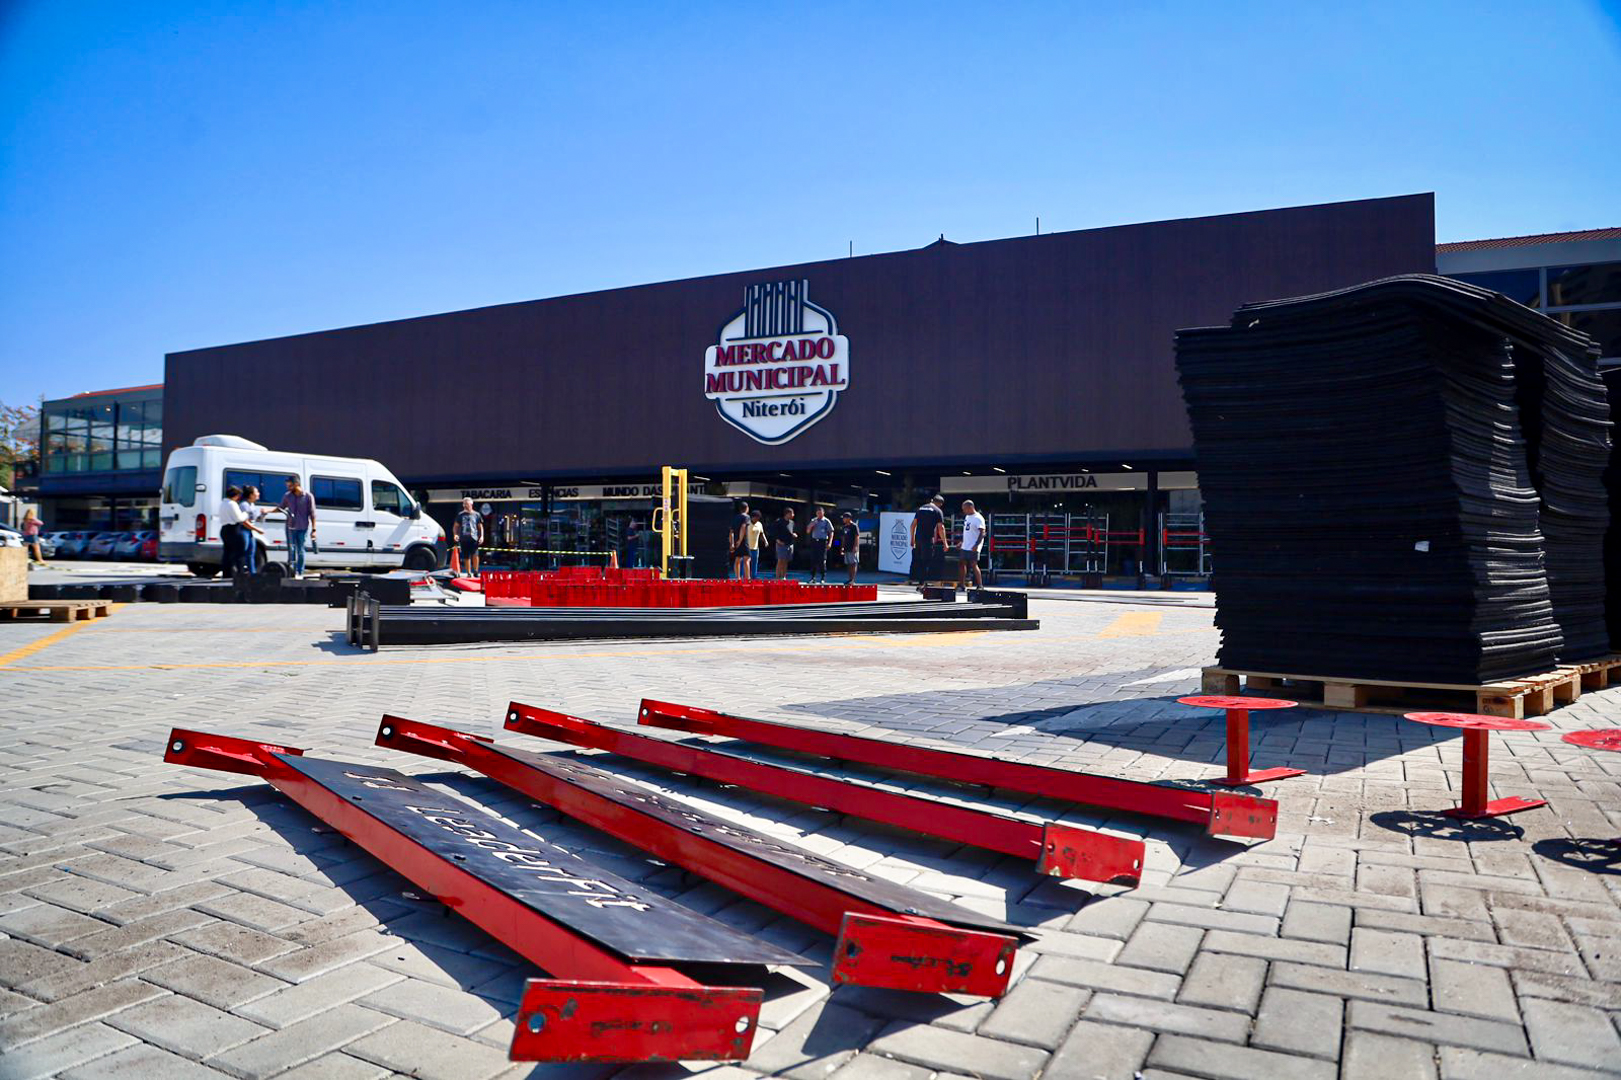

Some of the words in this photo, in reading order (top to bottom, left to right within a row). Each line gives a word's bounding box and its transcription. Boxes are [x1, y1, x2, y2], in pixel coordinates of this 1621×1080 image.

[714, 337, 836, 367] MERCADO
[706, 364, 846, 393] MUNICIPAL
[742, 398, 806, 418] Niterói
[1007, 475, 1098, 489] PLANTVIDA
[461, 489, 512, 499] TABACARIA
[528, 488, 579, 500] ESNCIAS
[602, 486, 639, 497] MUNDO
